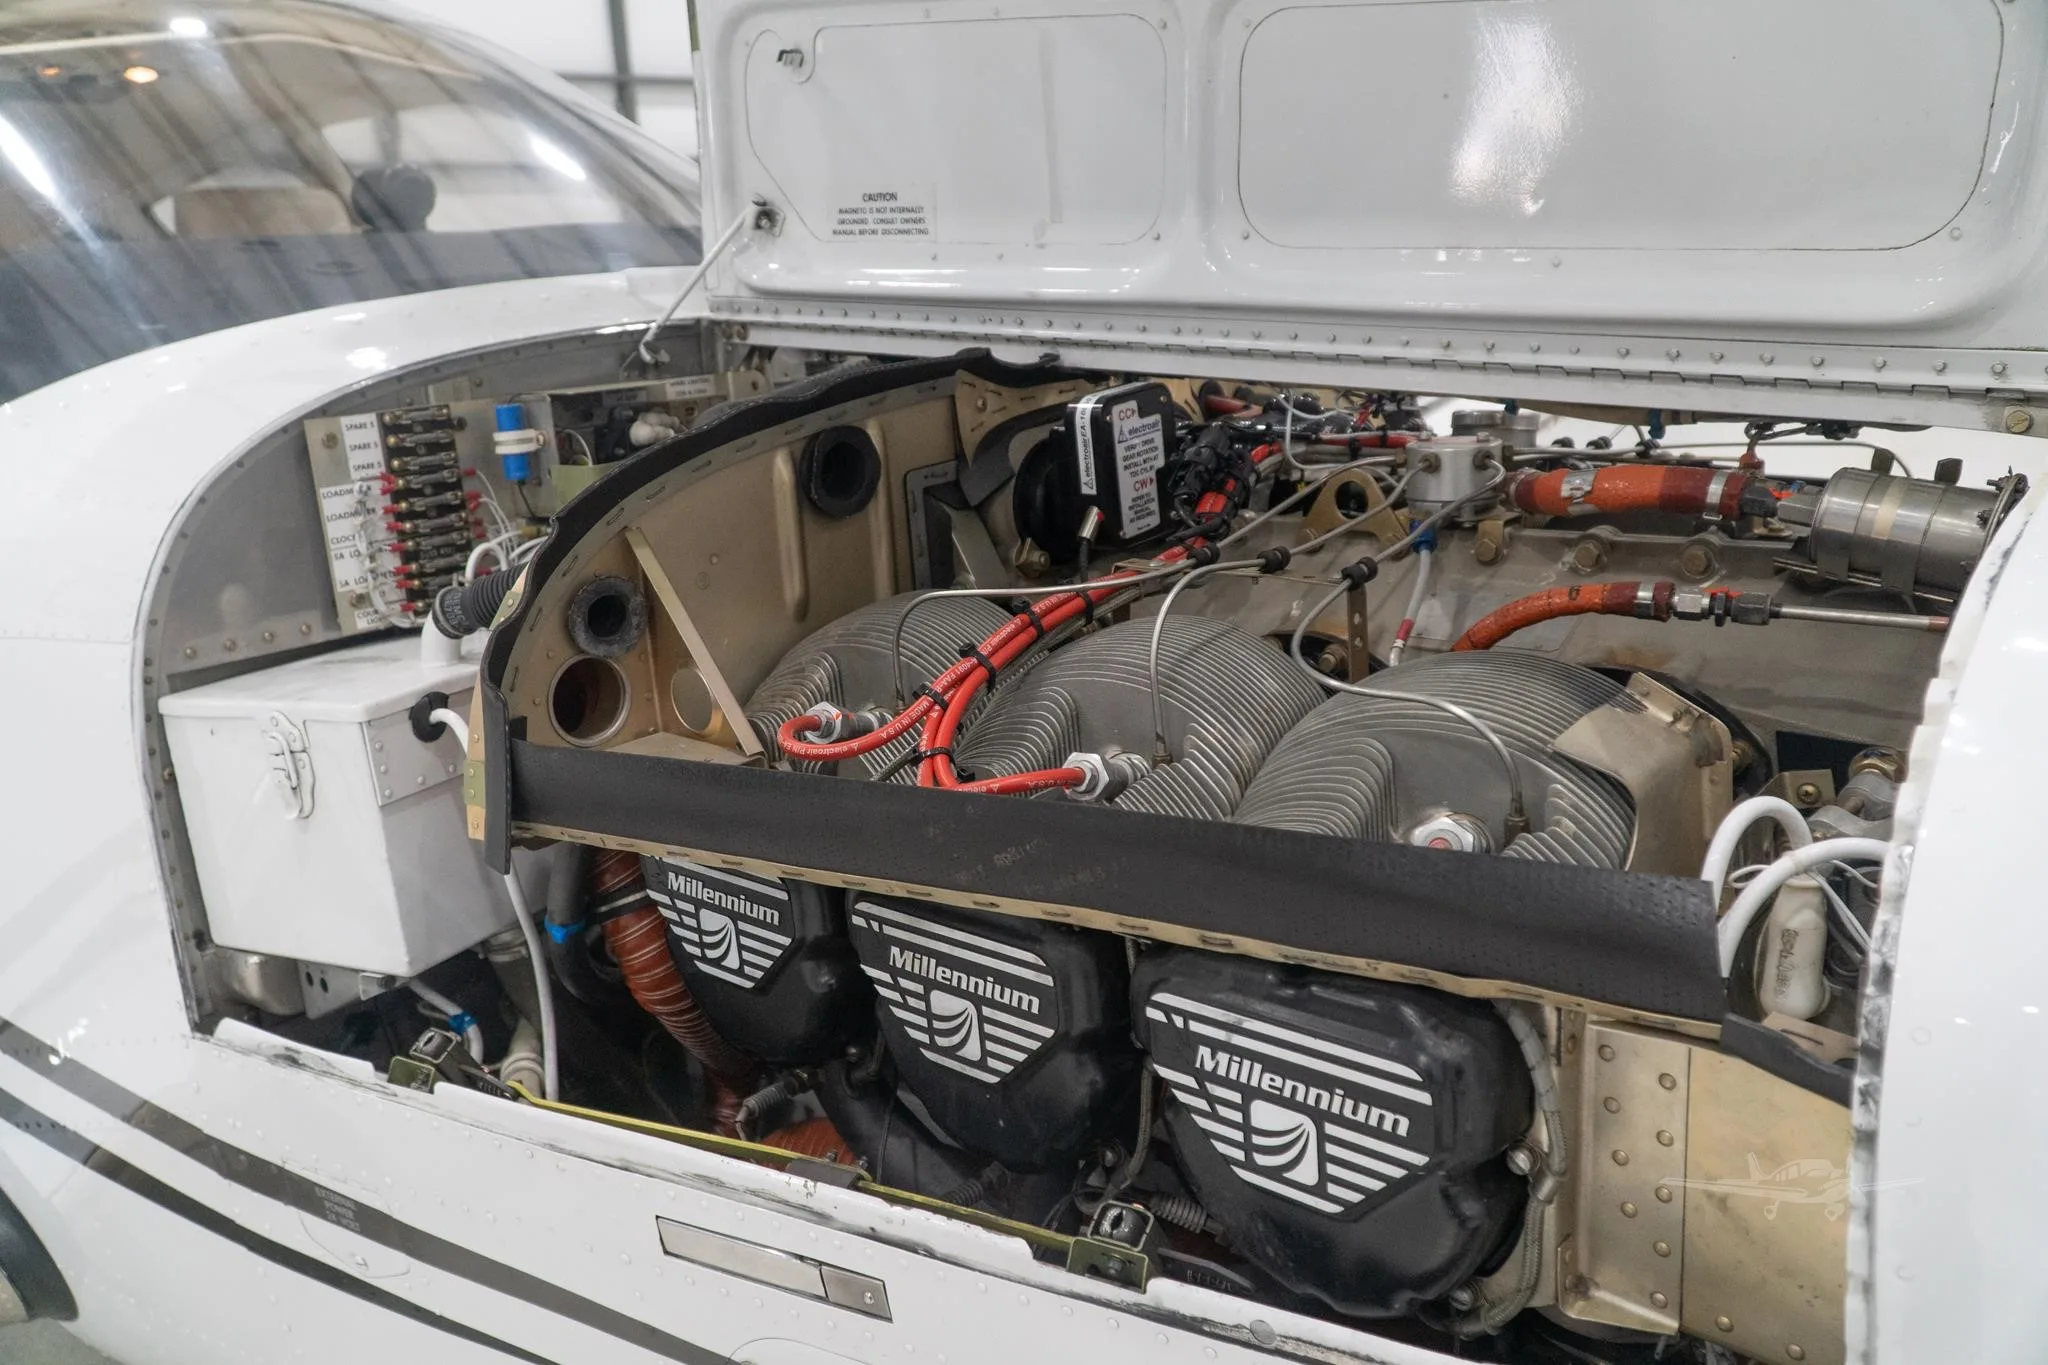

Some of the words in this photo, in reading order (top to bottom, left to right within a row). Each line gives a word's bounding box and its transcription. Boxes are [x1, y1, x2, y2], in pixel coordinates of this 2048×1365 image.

[862, 192, 898, 202] CAUTION
[838, 207, 867, 215] MAGNETO
[875, 206, 888, 214] NOT
[889, 206, 924, 214] INTERNALLY
[832, 228, 856, 236] MANUAL
[858, 228, 879, 236] BEFORE
[345, 422, 367, 431] SPARE
[1128, 419, 1160, 436] electroair
[349, 442, 371, 452] SPARE
[353, 463, 374, 471] SPARE
[330, 534, 355, 545] CLOC
[990, 623, 1015, 647] electroair
[909, 700, 930, 719] MADE
[901, 716, 911, 726] IN
[806, 744, 848, 756] electroair
[667, 871, 780, 926] Millennium
[889, 945, 1040, 1015] Millennium
[1195, 1044, 1410, 1138] Millennium
